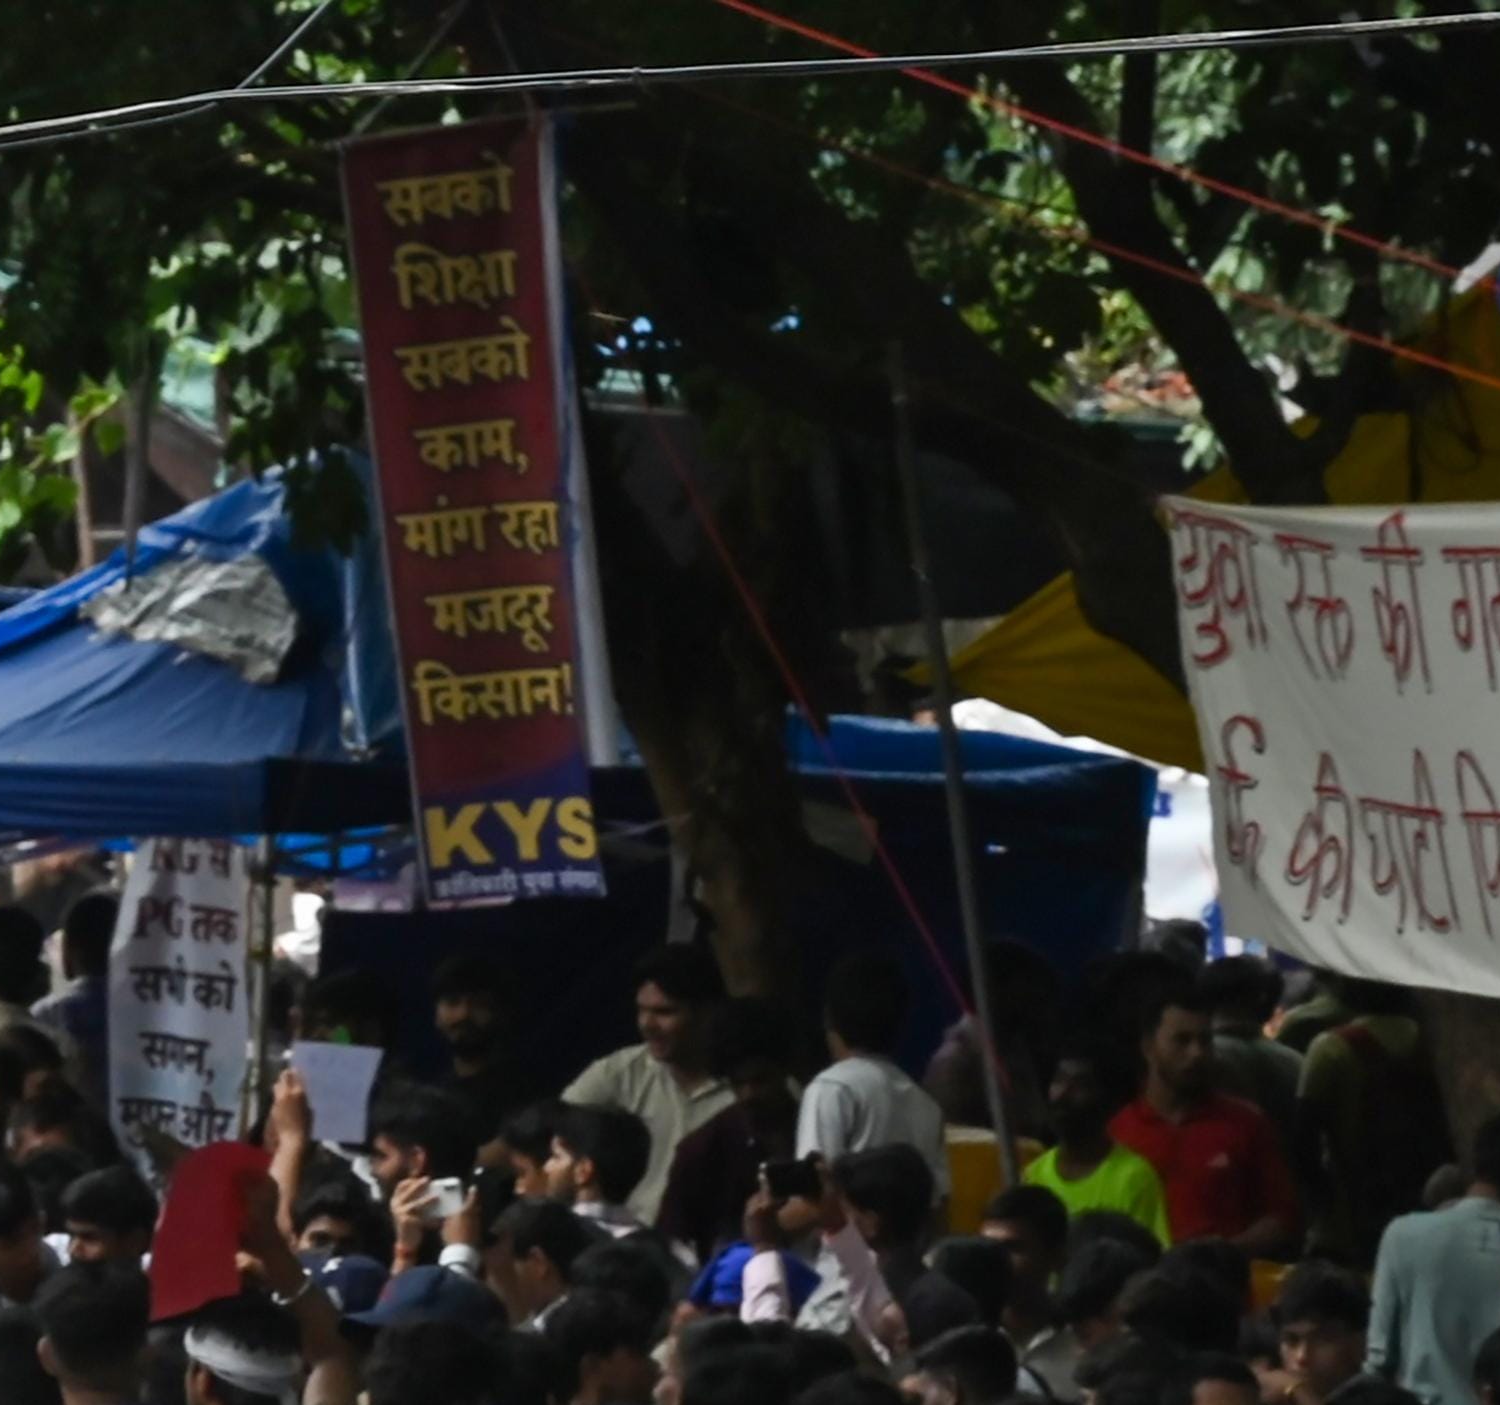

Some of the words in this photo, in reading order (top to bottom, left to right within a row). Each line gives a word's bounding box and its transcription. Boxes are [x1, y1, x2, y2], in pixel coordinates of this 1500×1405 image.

[376, 152, 513, 227] सबको
[391, 245, 516, 310] शिक्षा
[395, 316, 530, 391] सबको
[414, 419, 529, 474] काम,
[397, 494, 492, 560] मांग
[495, 500, 560, 553] रहा
[425, 584, 554, 653] मजदूर
[1173, 511, 1267, 670] युवा
[1360, 509, 1433, 697] की
[413, 658, 575, 726] किसान!
[424, 795, 599, 869] KYS
[1286, 749, 1355, 925] की
